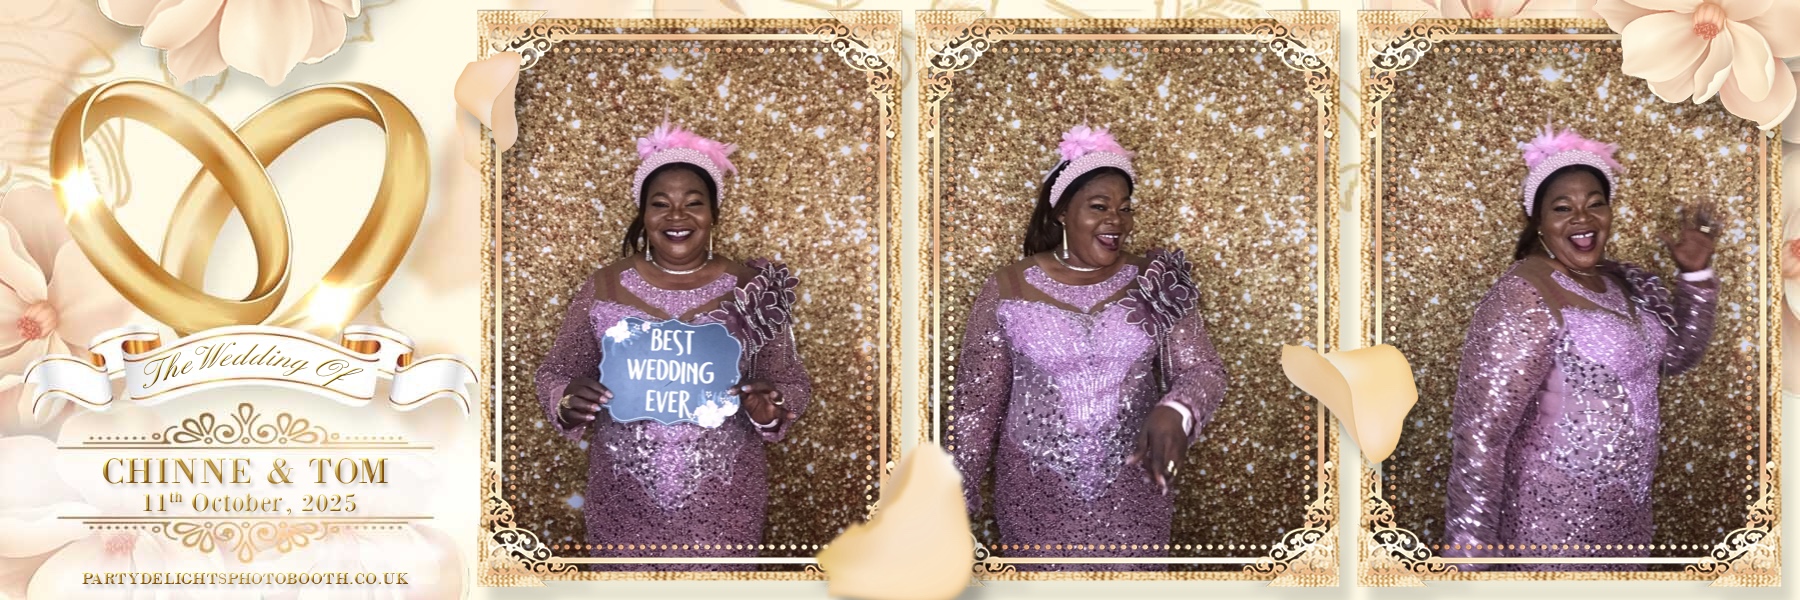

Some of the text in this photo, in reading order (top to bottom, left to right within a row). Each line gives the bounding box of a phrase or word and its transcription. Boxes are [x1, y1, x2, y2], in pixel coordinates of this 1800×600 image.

[651, 328, 695, 356] BEST
[627, 358, 715, 385] WEDDING
[645, 389, 692, 418] EVER
